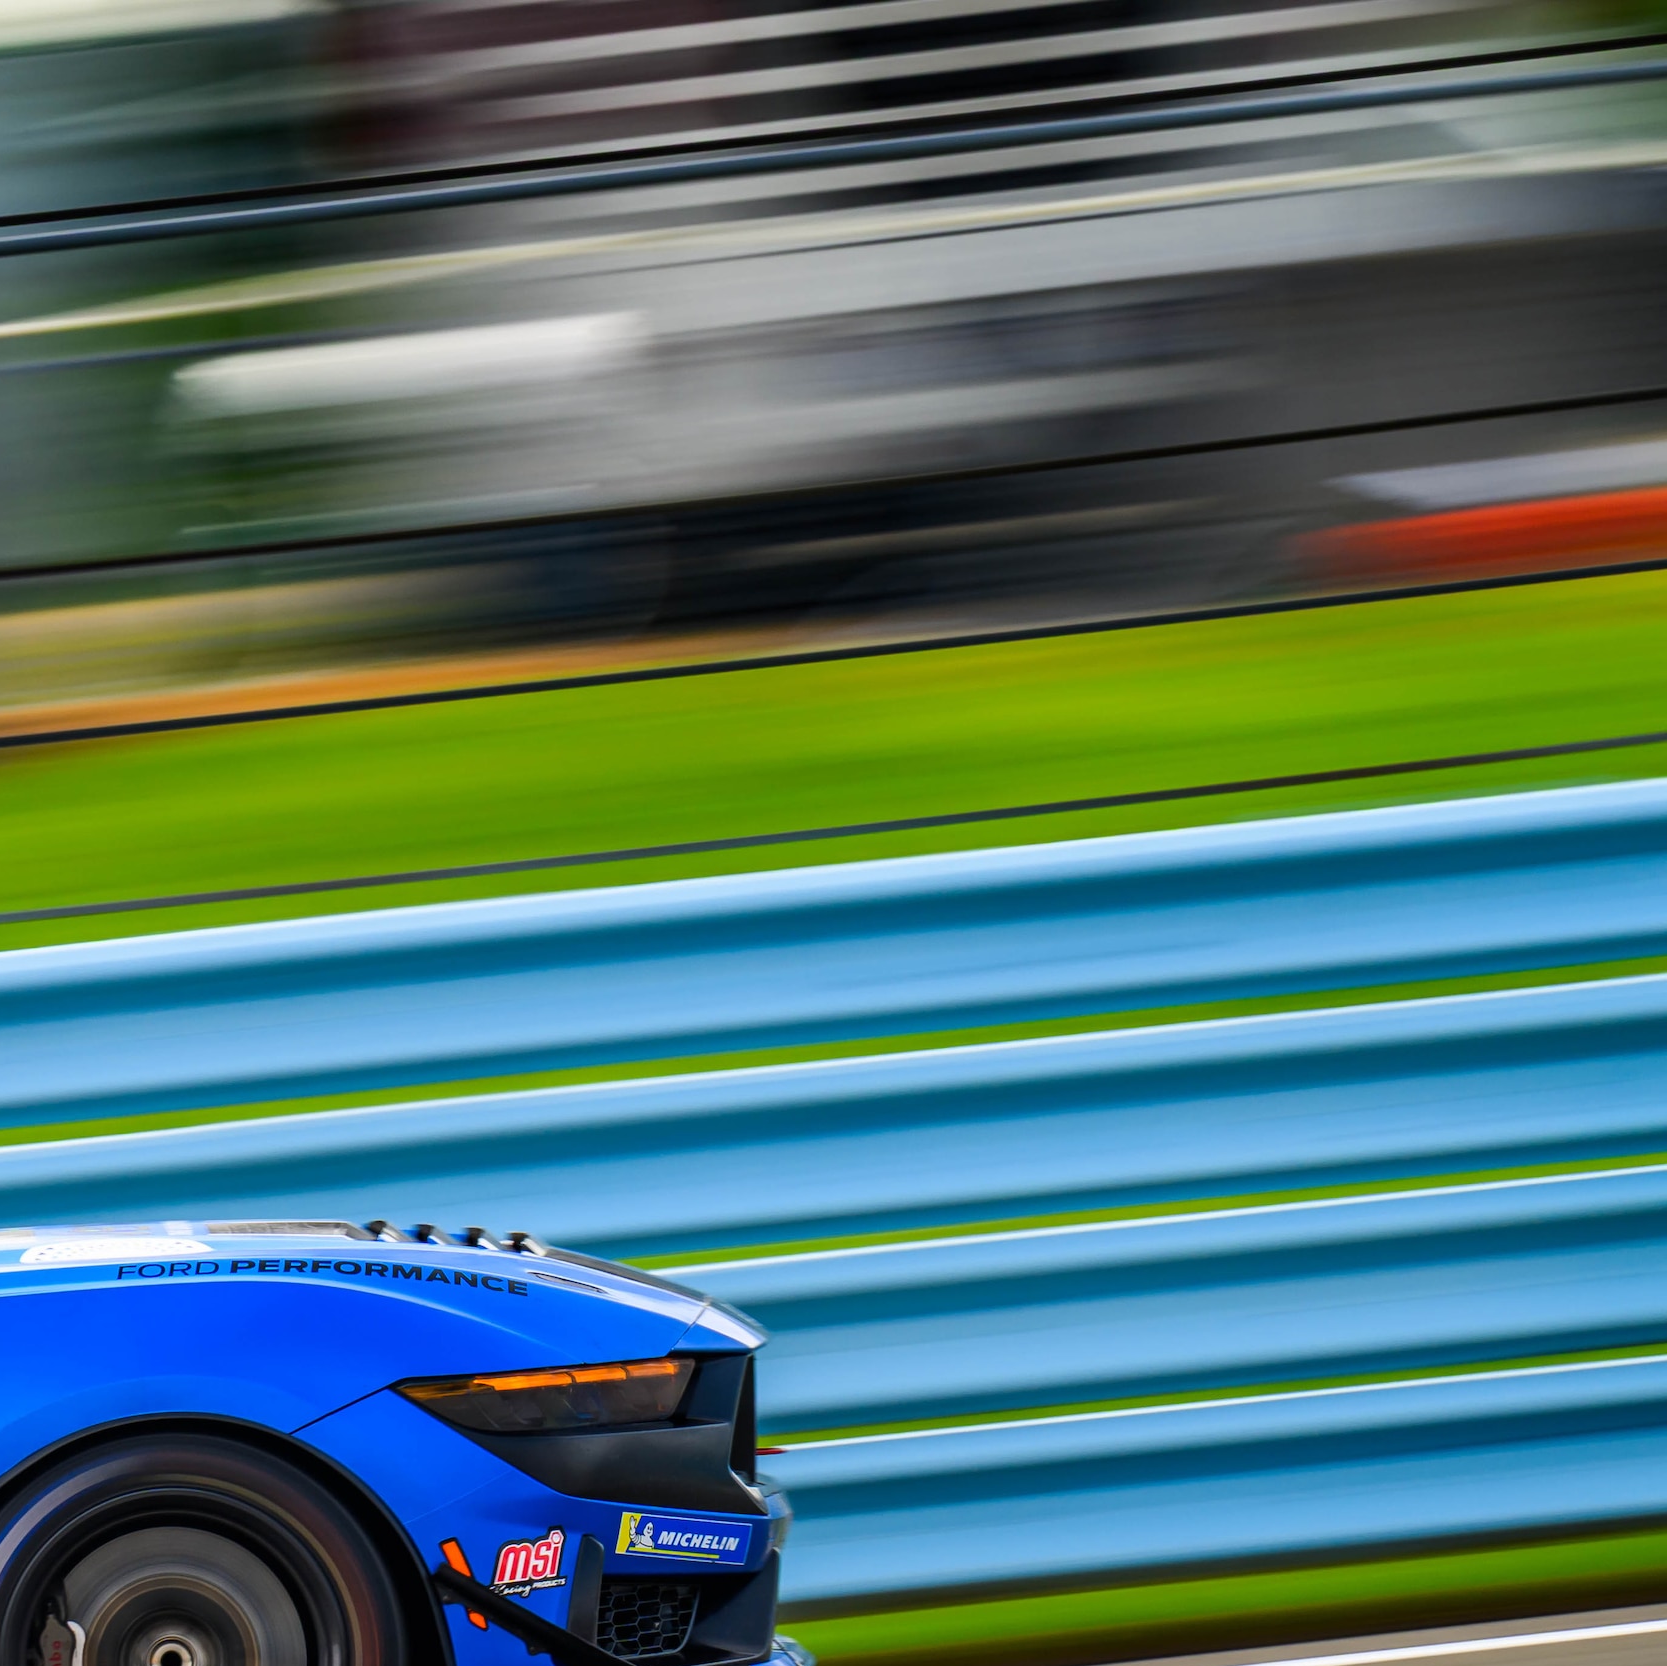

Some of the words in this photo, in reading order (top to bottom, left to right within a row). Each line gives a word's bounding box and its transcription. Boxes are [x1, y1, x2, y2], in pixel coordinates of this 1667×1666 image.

[117, 1261, 220, 1280] FORD
[230, 1259, 528, 1297] PERFORMANCE
[657, 1531, 739, 1551] MICHELIN
